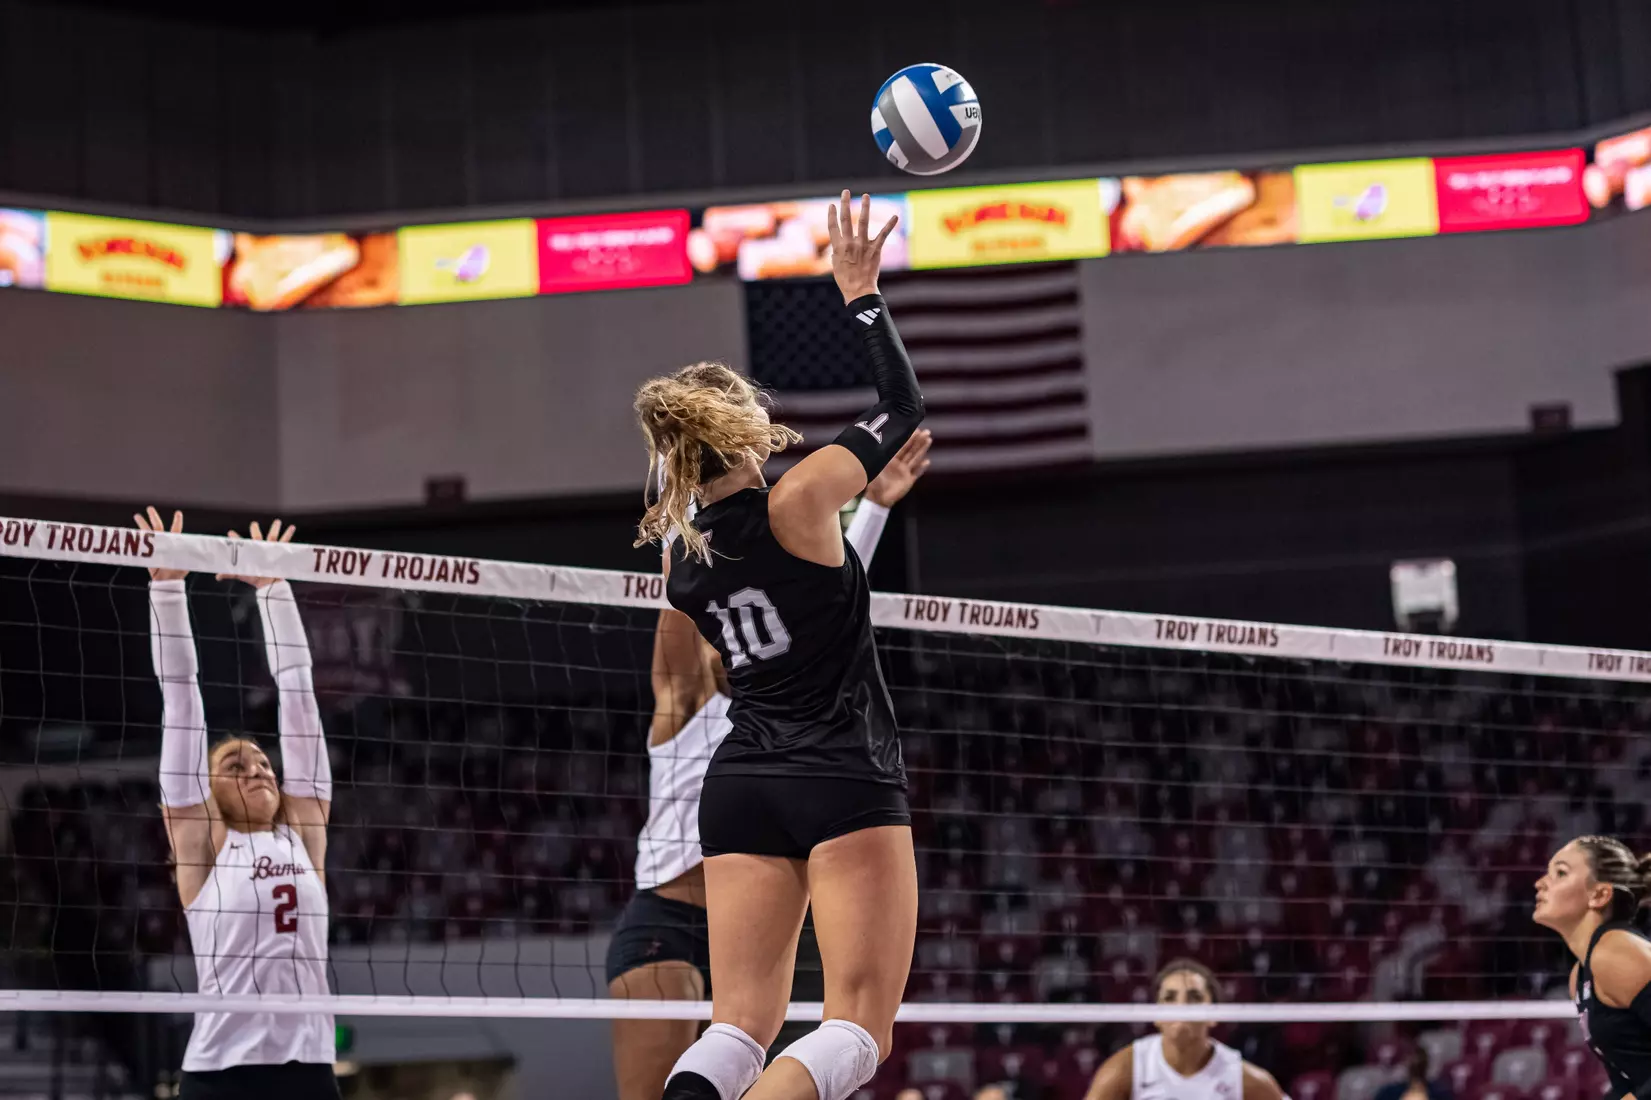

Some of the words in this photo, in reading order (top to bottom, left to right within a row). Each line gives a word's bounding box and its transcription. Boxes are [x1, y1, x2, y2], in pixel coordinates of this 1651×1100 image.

[0, 520, 36, 547] OY
[47, 524, 156, 558] TROJANS
[313, 548, 372, 576] TROY
[381, 554, 480, 585] TROJANS
[623, 574, 663, 599] TRO
[705, 586, 792, 669] 10
[903, 598, 952, 623] TROY
[959, 603, 1040, 630] TROJANS
[1156, 619, 1200, 642] TROY
[1205, 623, 1279, 648] TROJANS
[1383, 637, 1423, 658] TROY
[1428, 641, 1494, 664] TROJANS
[1588, 653, 1622, 672] TROY
[249, 856, 305, 880] Bama
[272, 884, 297, 934] 2
